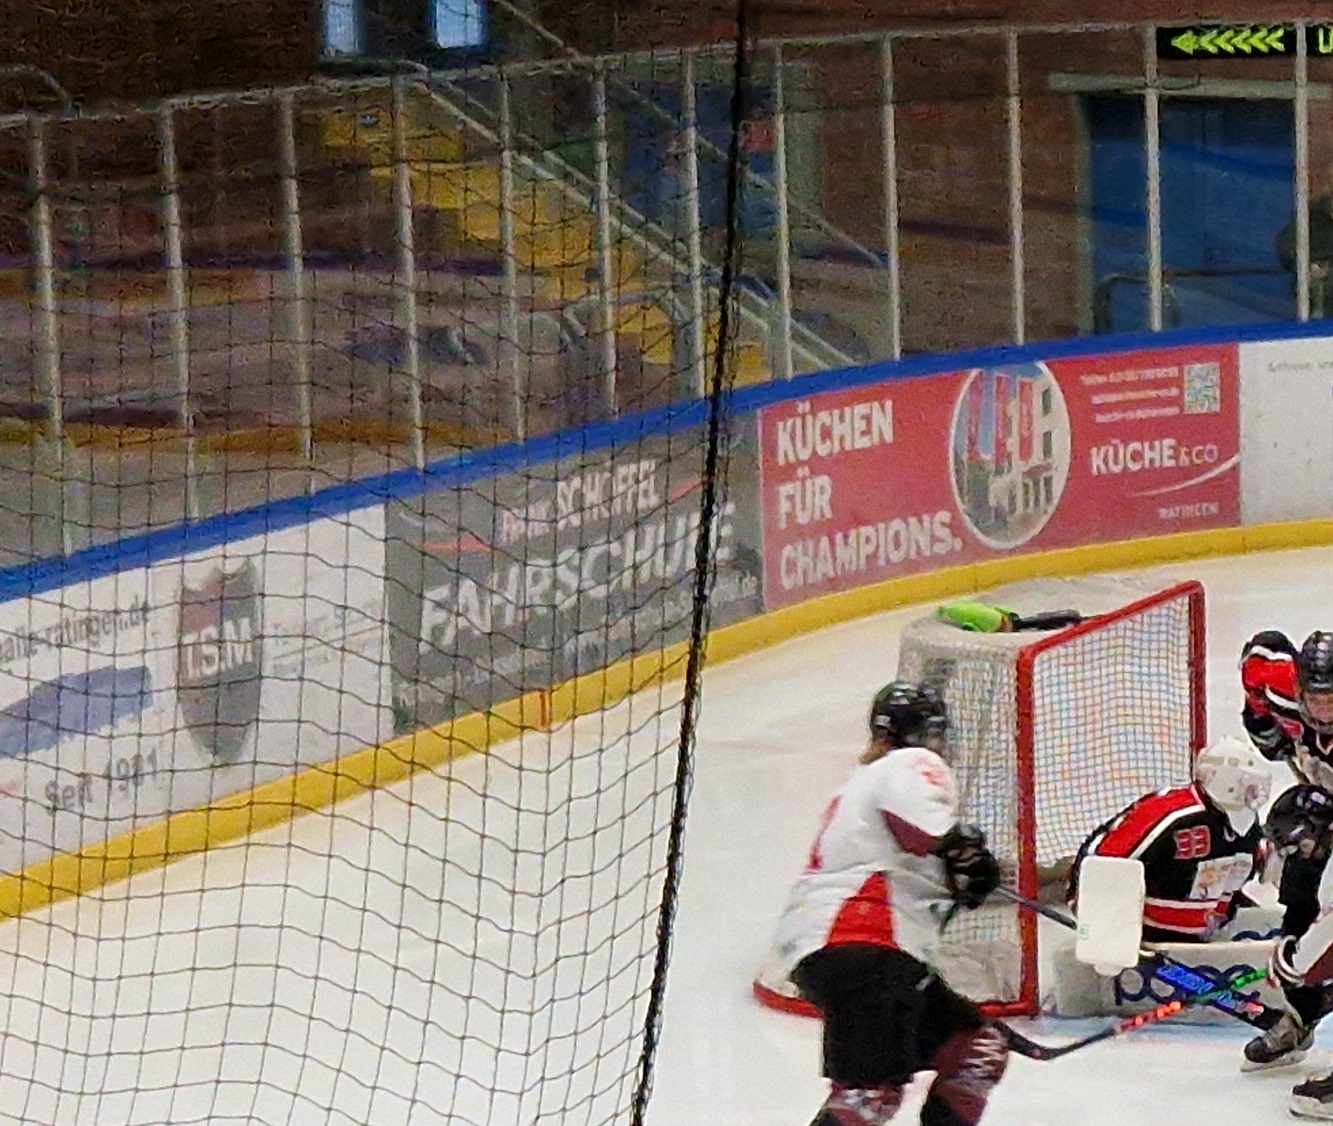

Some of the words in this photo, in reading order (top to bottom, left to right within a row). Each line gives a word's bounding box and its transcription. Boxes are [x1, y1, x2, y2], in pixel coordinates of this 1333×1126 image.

[775, 398, 894, 466] KÜCHEN
[1090, 438, 1176, 475] KÜCHE
[777, 467, 832, 530] FÜR
[780, 510, 964, 591] CHAMPIONS.
